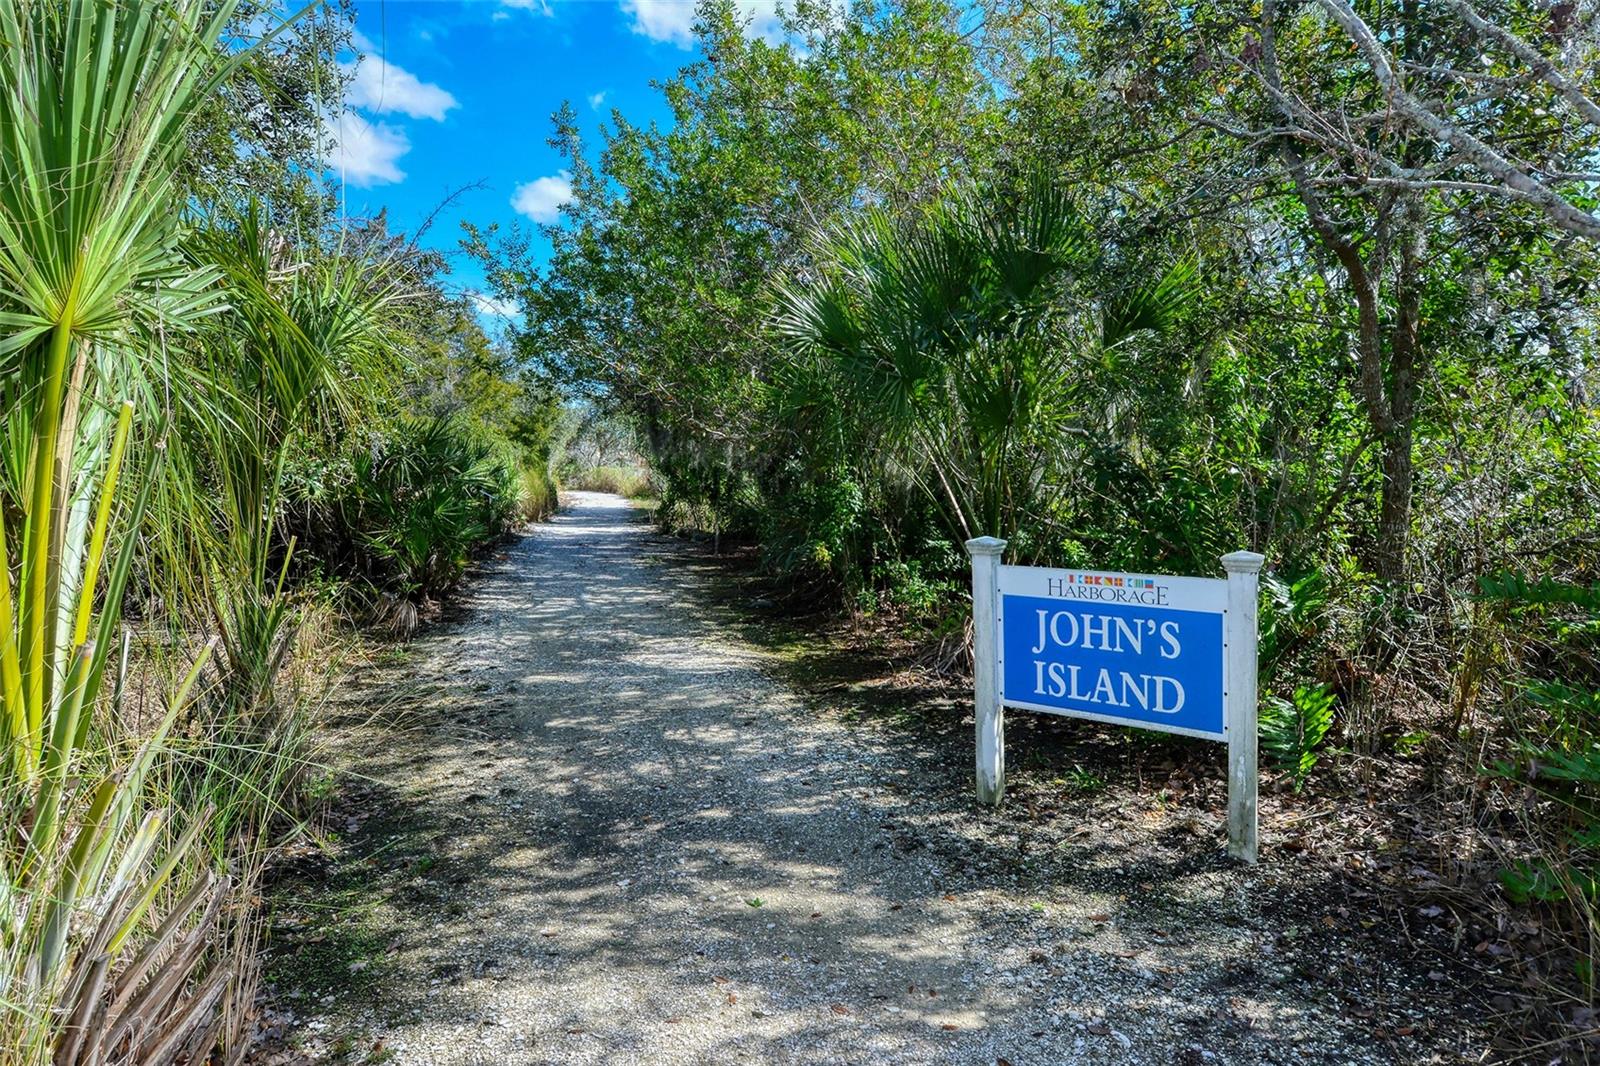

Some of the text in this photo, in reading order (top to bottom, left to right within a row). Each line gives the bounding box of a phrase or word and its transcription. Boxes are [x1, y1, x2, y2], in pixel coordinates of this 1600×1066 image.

[1048, 578, 1169, 606] HARBORAGE
[1032, 609, 1181, 659] JOHN'S
[1033, 660, 1185, 714] ISLAND
